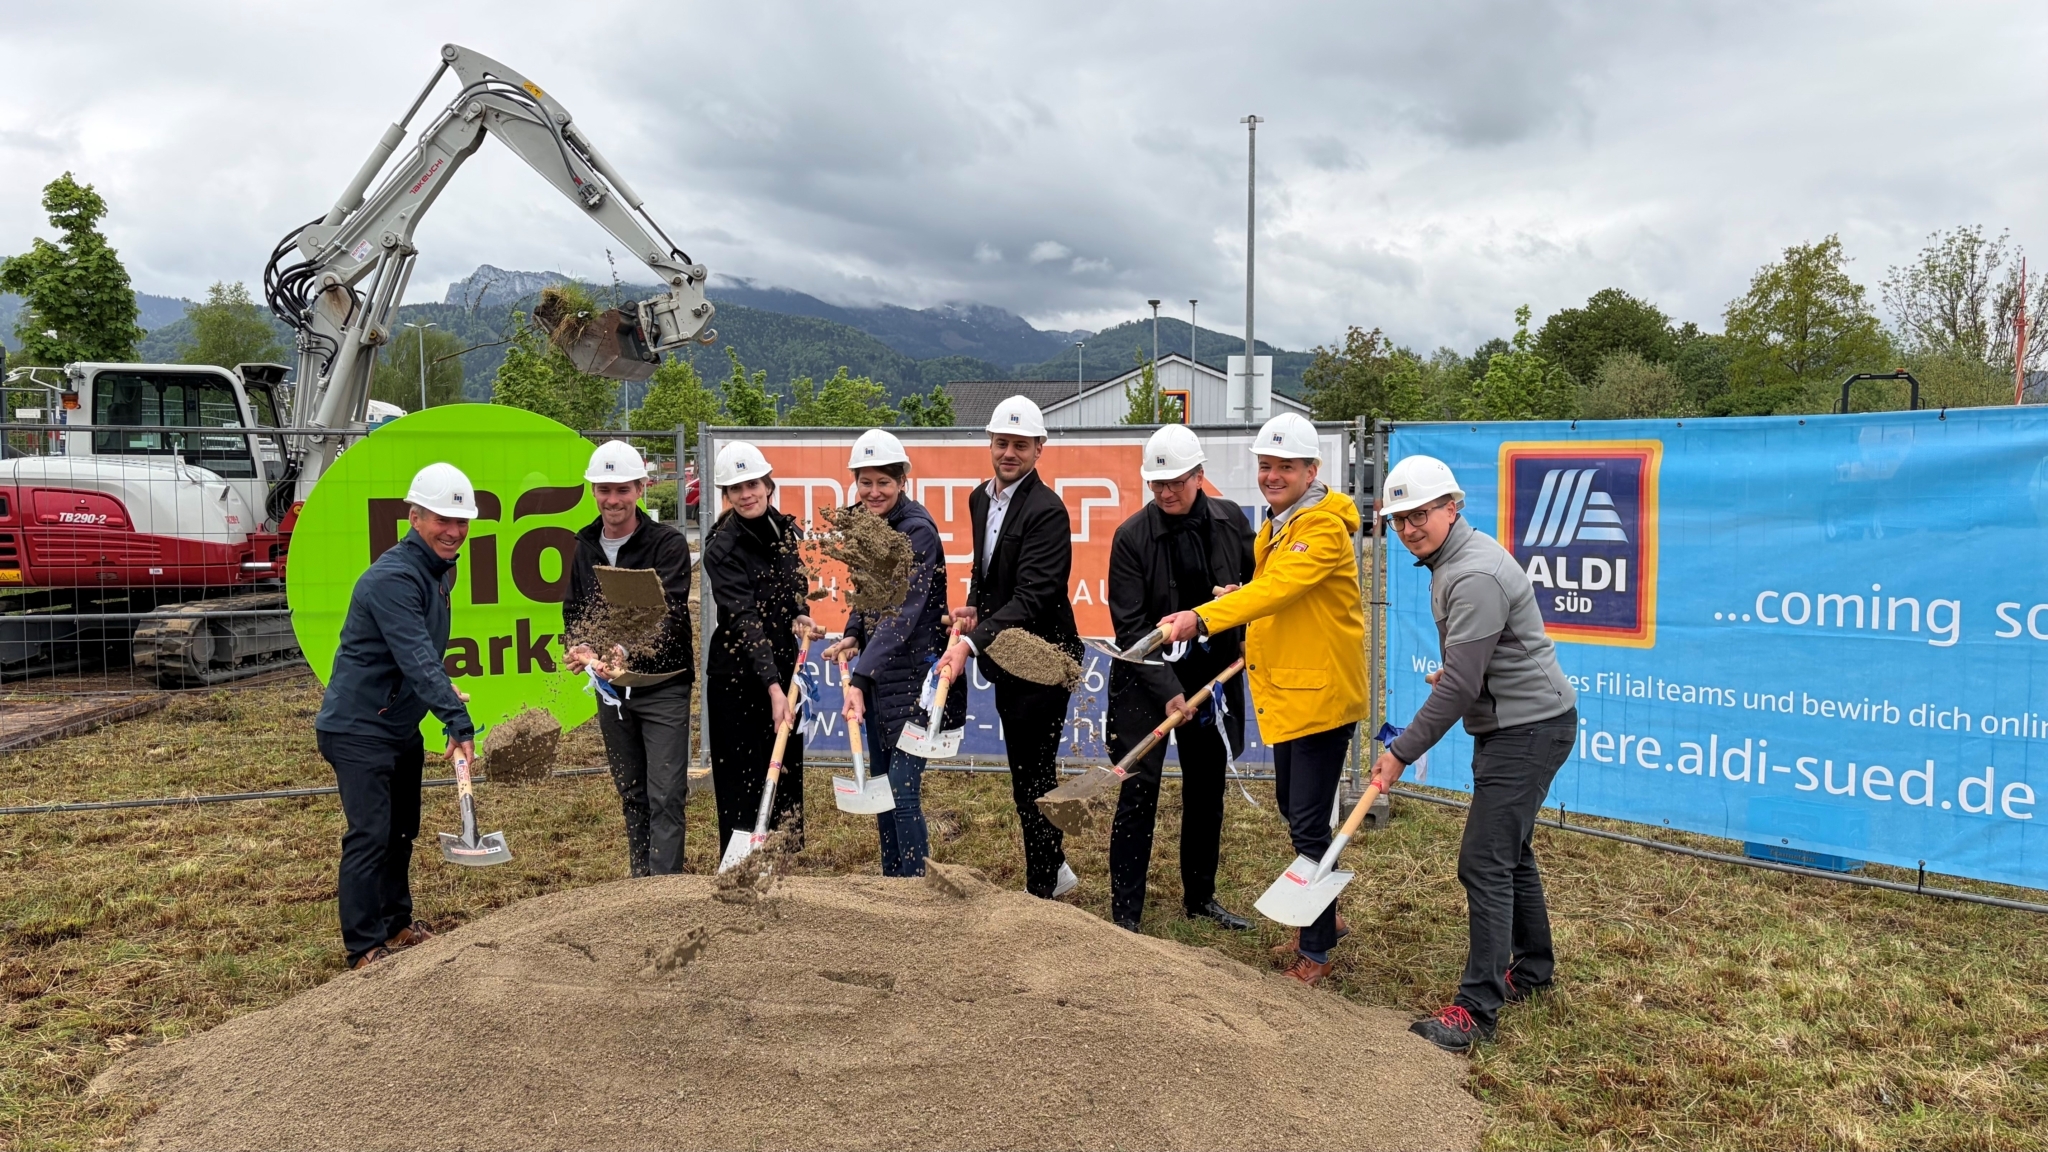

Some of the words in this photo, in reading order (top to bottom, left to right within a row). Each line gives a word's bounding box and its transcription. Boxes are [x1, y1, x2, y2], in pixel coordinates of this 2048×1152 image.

[408, 158, 444, 195] TAKEUCHI
[59, 512, 107, 524] TB290-2
[1525, 555, 1627, 592] ALDI
[1554, 591, 1593, 613] SÜD
[1743, 691, 1794, 713] und
[1802, 692, 1900, 724] bewirb
[1908, 703, 1971, 731] dich
